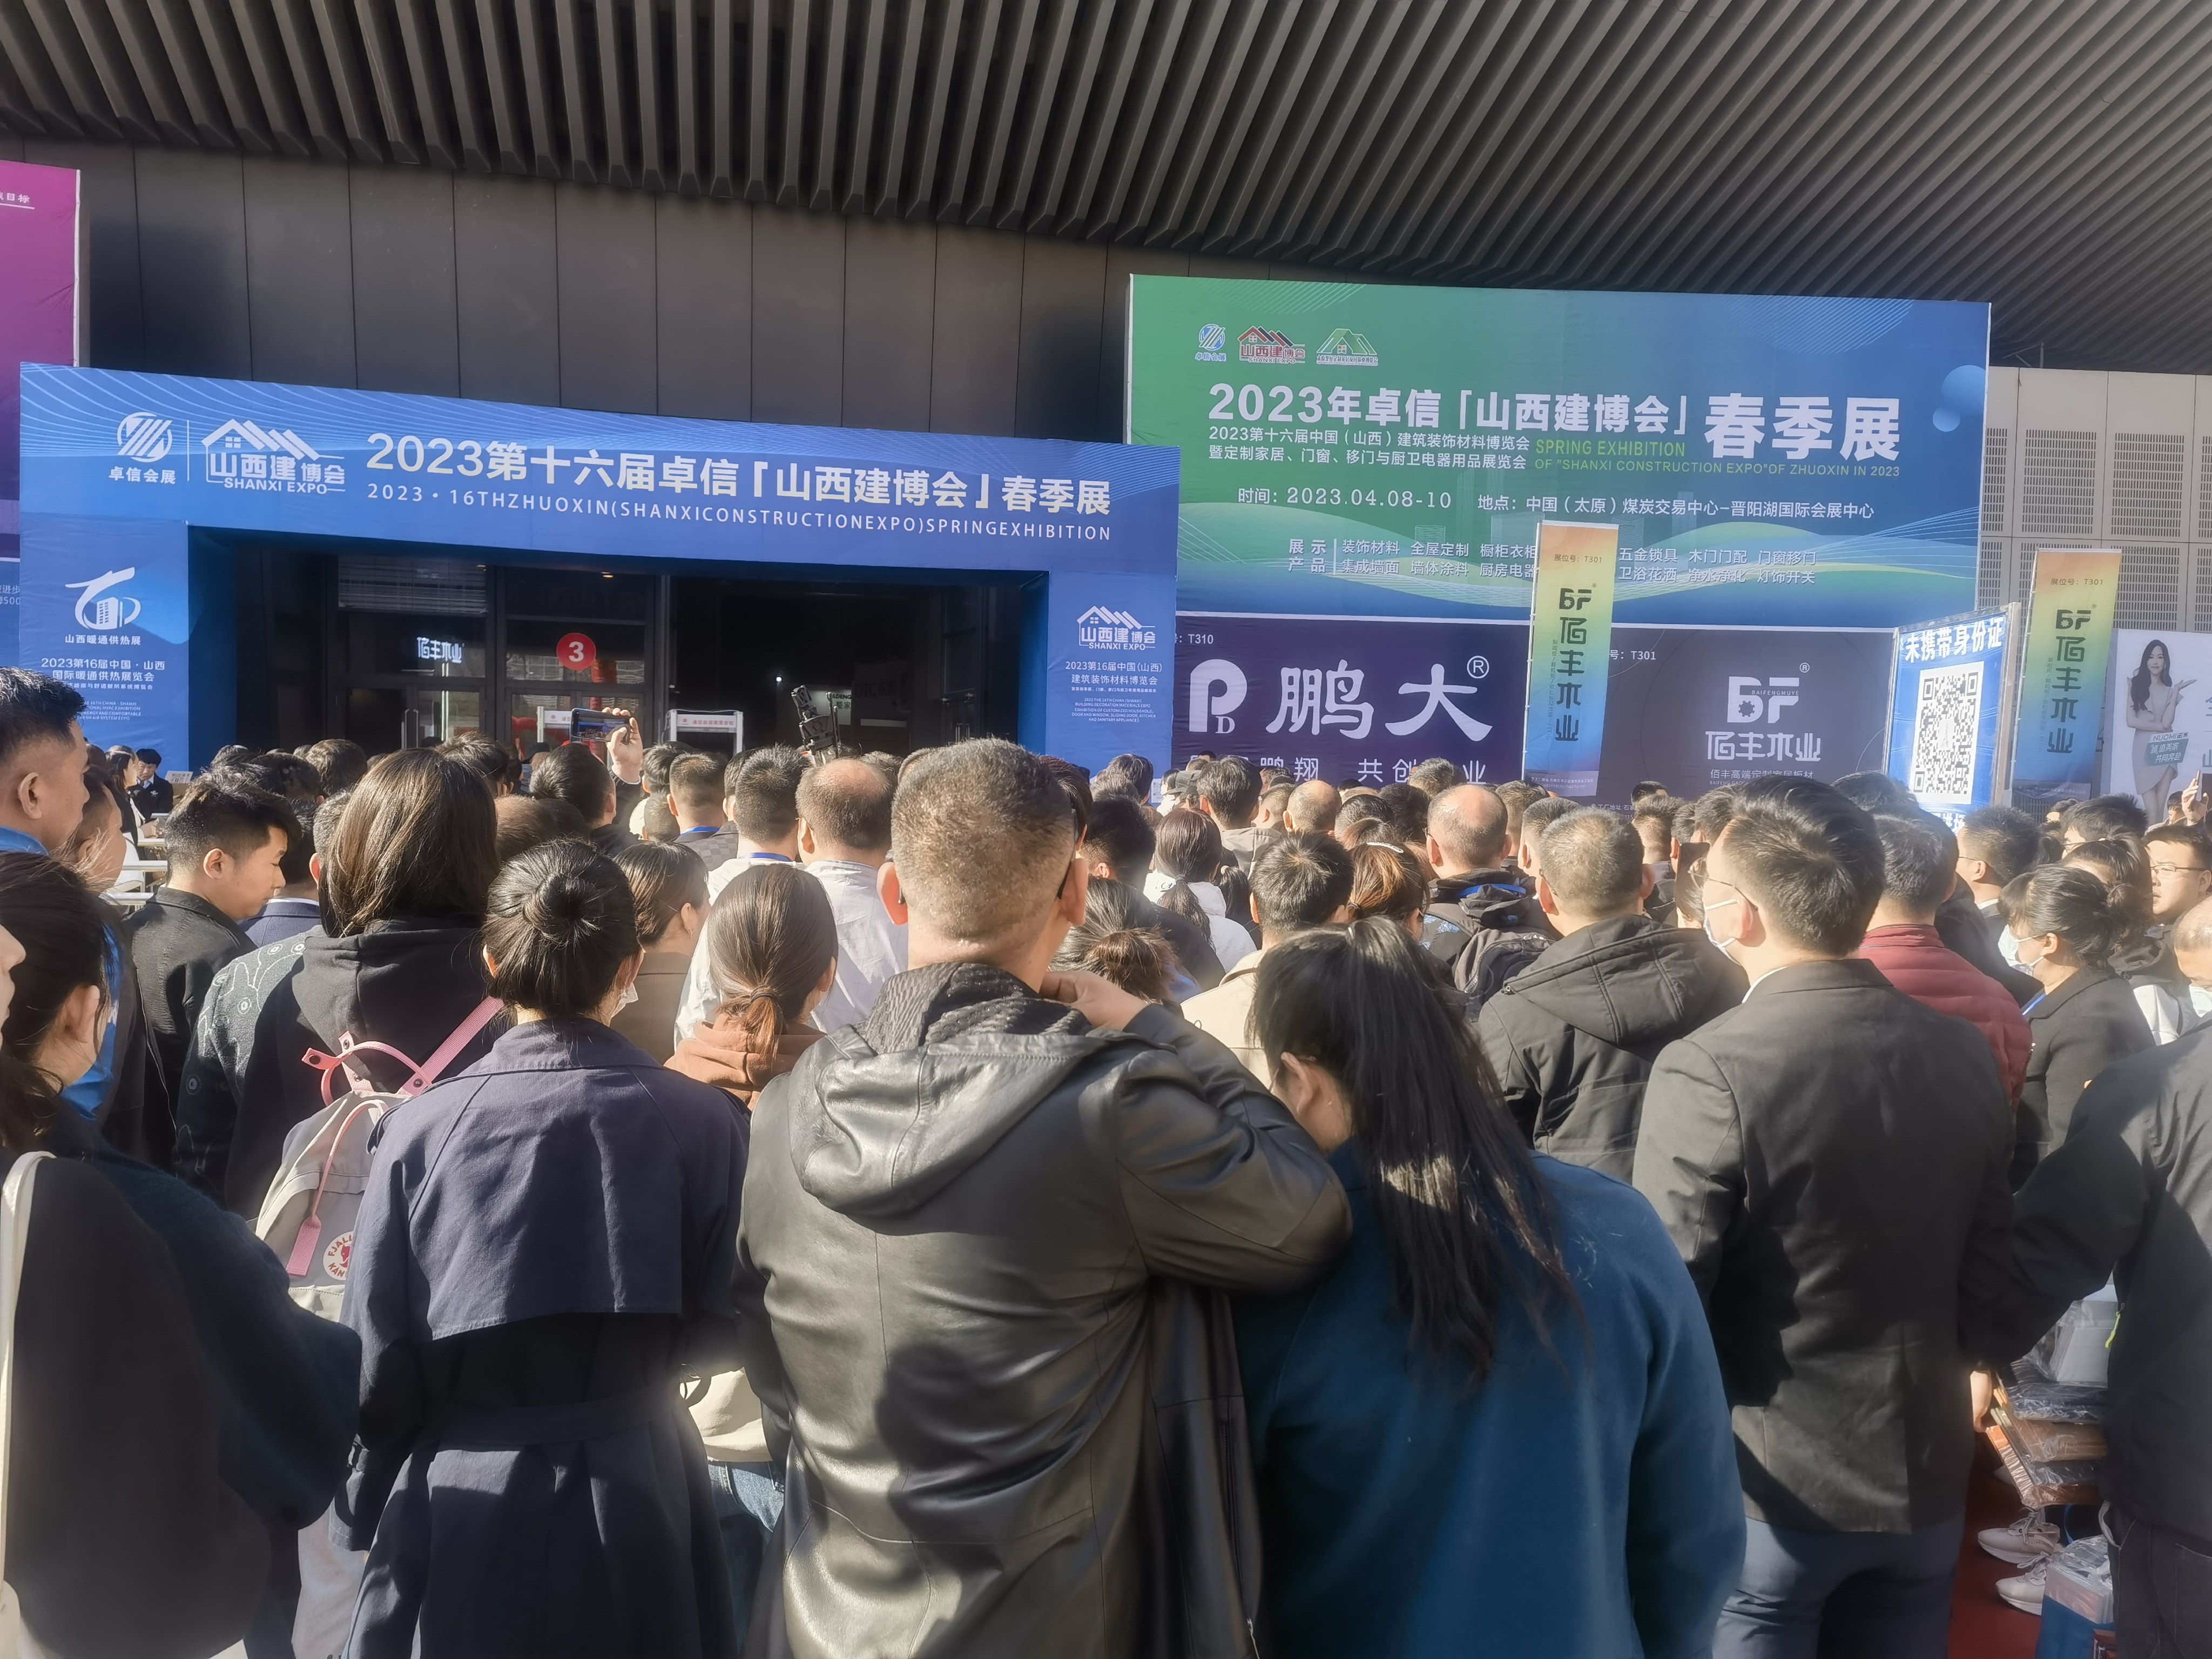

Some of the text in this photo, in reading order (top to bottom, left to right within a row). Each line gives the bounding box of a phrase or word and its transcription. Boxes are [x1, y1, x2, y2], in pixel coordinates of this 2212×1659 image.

[1195, 351, 1227, 362] 卓信会展
[1240, 343, 1305, 359] 山西建博会
[1536, 438, 1685, 457] SPRING EXHIBITION
[108, 466, 177, 485] 卓信会展
[210, 451, 346, 485] 山西建博会
[1535, 459, 1553, 470] OF
[1616, 461, 1722, 474] CONSTRUCTION
[1790, 464, 1849, 476] ZHUOXIN
[1853, 466, 1866, 476] IN
[1871, 466, 1900, 477] 2023
[224, 477, 327, 495] SHANXI EXPO
[1342, 539, 1400, 555] 装饰材料
[1411, 542, 1469, 557] 全屋定制
[1480, 543, 1536, 559] 橱柜衣柜
[1618, 547, 1678, 563] 五金锁具
[1689, 549, 1747, 564] 木门门配
[1758, 550, 1817, 566] 门窗移门
[1341, 558, 1400, 574] 集成墙面
[1411, 559, 1469, 577] 墙体涂料
[1480, 562, 1536, 578] 厨房电器
[1618, 566, 1677, 582] 卫浴花洒
[1688, 568, 1746, 583] 净水净化
[1757, 570, 1816, 584] 灯饰开关
[65, 634, 141, 646] 山西暖通供热展
[1081, 626, 1155, 644] 山西建博会
[1905, 617, 2004, 663] 未携带身份证
[568, 641, 584, 663] 3
[52, 670, 155, 682] 国际暖通供热展览会
[1071, 674, 1158, 686] 建筑装饰材料博览会
